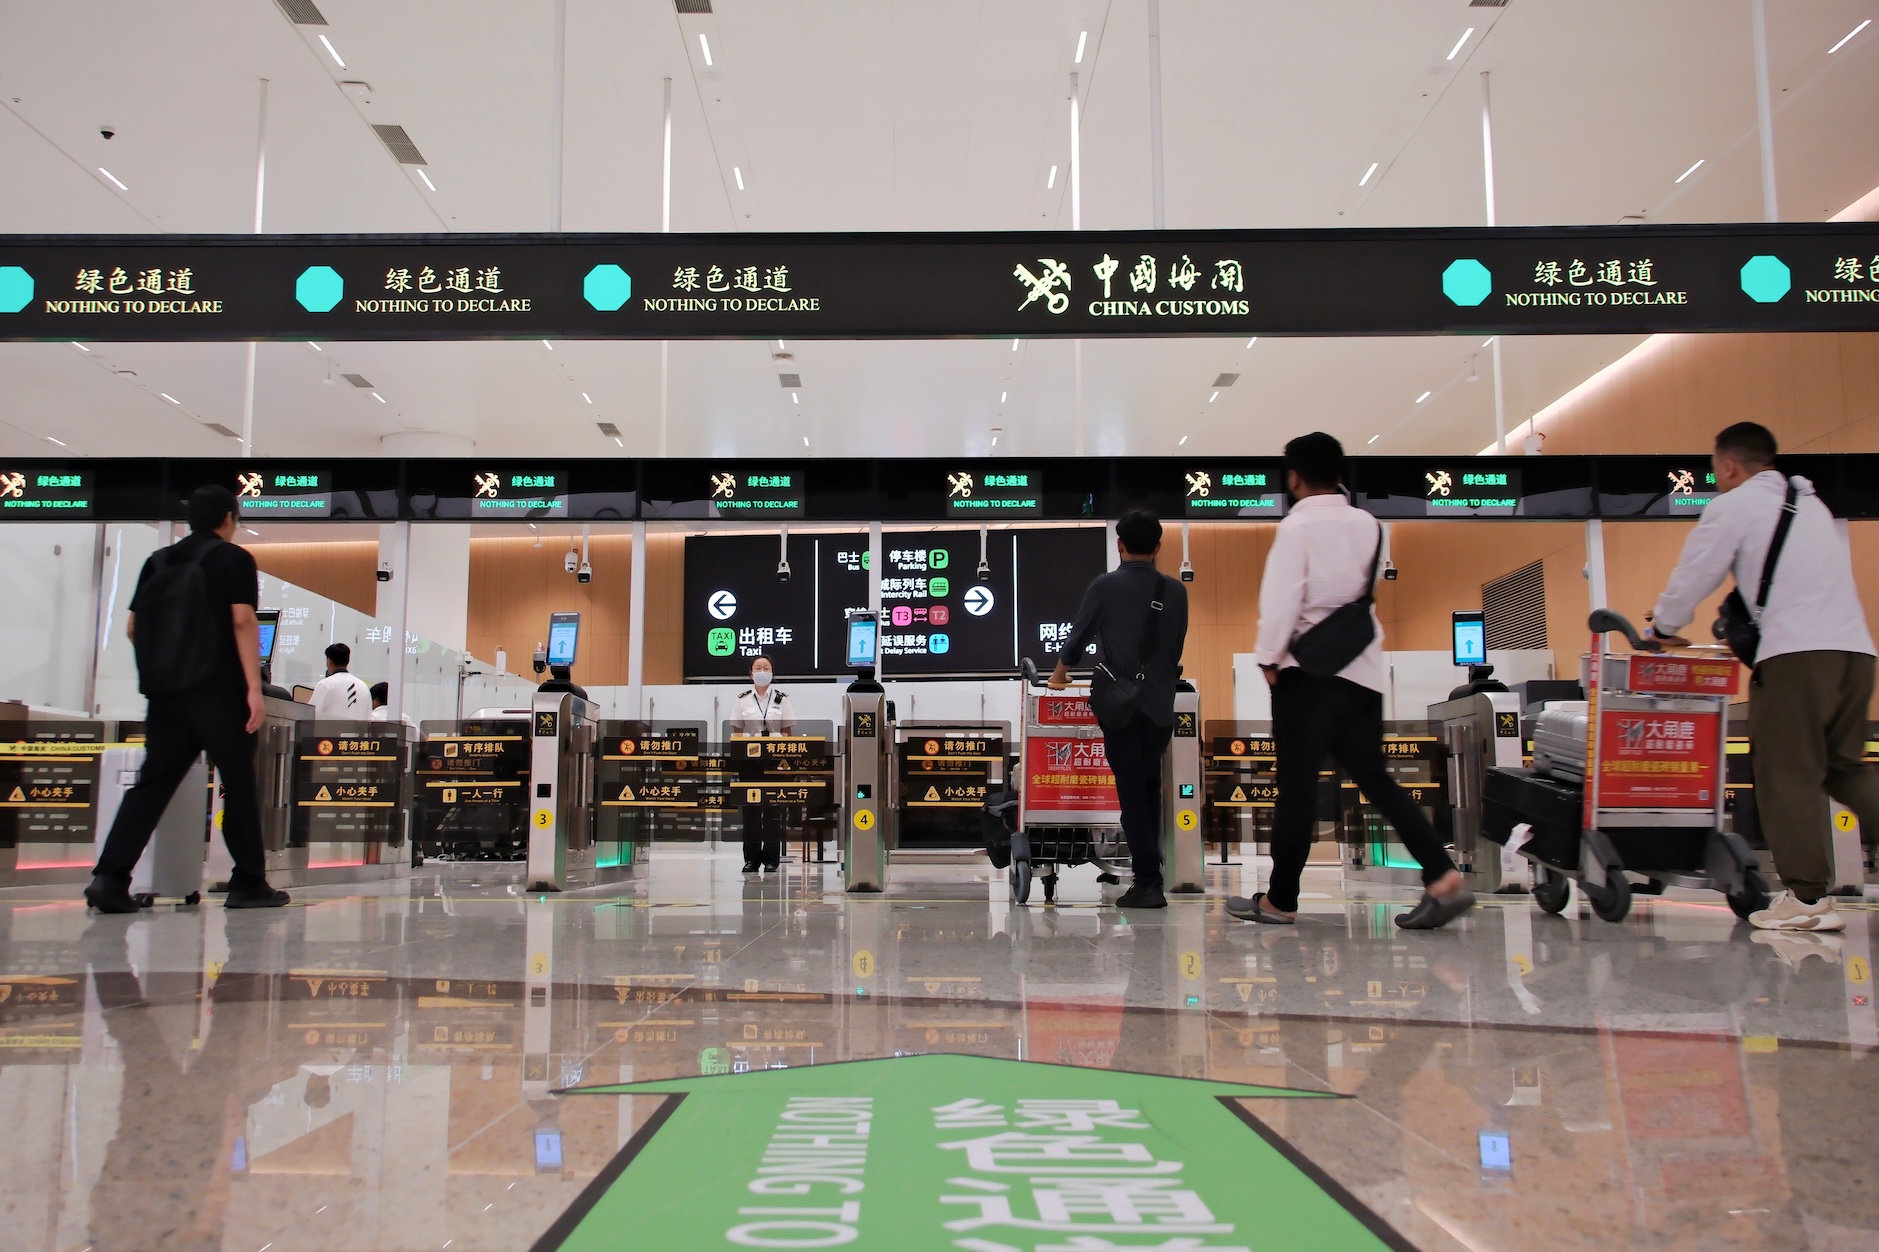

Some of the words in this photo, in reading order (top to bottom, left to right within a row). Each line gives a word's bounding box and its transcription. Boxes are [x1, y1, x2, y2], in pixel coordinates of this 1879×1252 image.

[1534, 258, 1658, 286] 绿色通道
[75, 267, 195, 295] 绿色通道
[385, 266, 504, 294] 绿色通道
[673, 265, 792, 292] 绿色通道
[643, 298, 717, 312] NOTHING
[720, 298, 743, 312] TO
[746, 298, 820, 311] DECLARE
[1505, 293, 1581, 306] NOTHING
[1584, 293, 1607, 305] TO
[1610, 292, 1687, 305] DECLARE
[46, 300, 120, 314] NOTHING
[123, 300, 146, 314] TO
[148, 300, 223, 314] DECLARE
[356, 299, 429, 313] NOTHING
[431, 299, 454, 313] TO
[456, 298, 531, 312] DECLARE
[1089, 302, 1152, 316] CHINA
[1155, 301, 1250, 315] CUSTOMS
[37, 475, 81, 487] 绿色通道
[275, 475, 318, 487] 绿色通道
[512, 475, 554, 487] 绿色通道
[748, 475, 791, 487] 绿色通道
[984, 474, 1028, 487] 绿色通道
[1222, 474, 1266, 486] 绿色通道
[1463, 474, 1507, 486] 绿色通道
[838, 551, 860, 563] 巴士
[889, 550, 927, 562] 停车楼
[898, 562, 928, 571] Parking
[896, 612, 908, 620] T3
[932, 610, 946, 620] T2
[739, 627, 792, 645] 出租车
[740, 646, 762, 656] Taxi
[1646, 720, 1695, 740] 大角鹿
[338, 741, 380, 751] 请勿推门
[463, 742, 504, 753] 有序排队
[640, 740, 682, 751] 请勿推门
[766, 742, 808, 753] 有序排队
[944, 740, 986, 751] 请勿推门
[30, 787, 74, 798] 小心夹手
[336, 786, 378, 796] 小心夹手
[462, 788, 503, 798] 一人一行
[640, 786, 682, 796] 小心夹手
[766, 788, 808, 799] 一人一行
[944, 786, 986, 796] 小心夹手
[540, 814, 546, 824] 3
[860, 815, 868, 824] 4
[1184, 815, 1190, 824] 5
[1841, 816, 1848, 826] 7
[748, 1097, 874, 1194] NOTHING
[725, 1200, 861, 1248] TO
